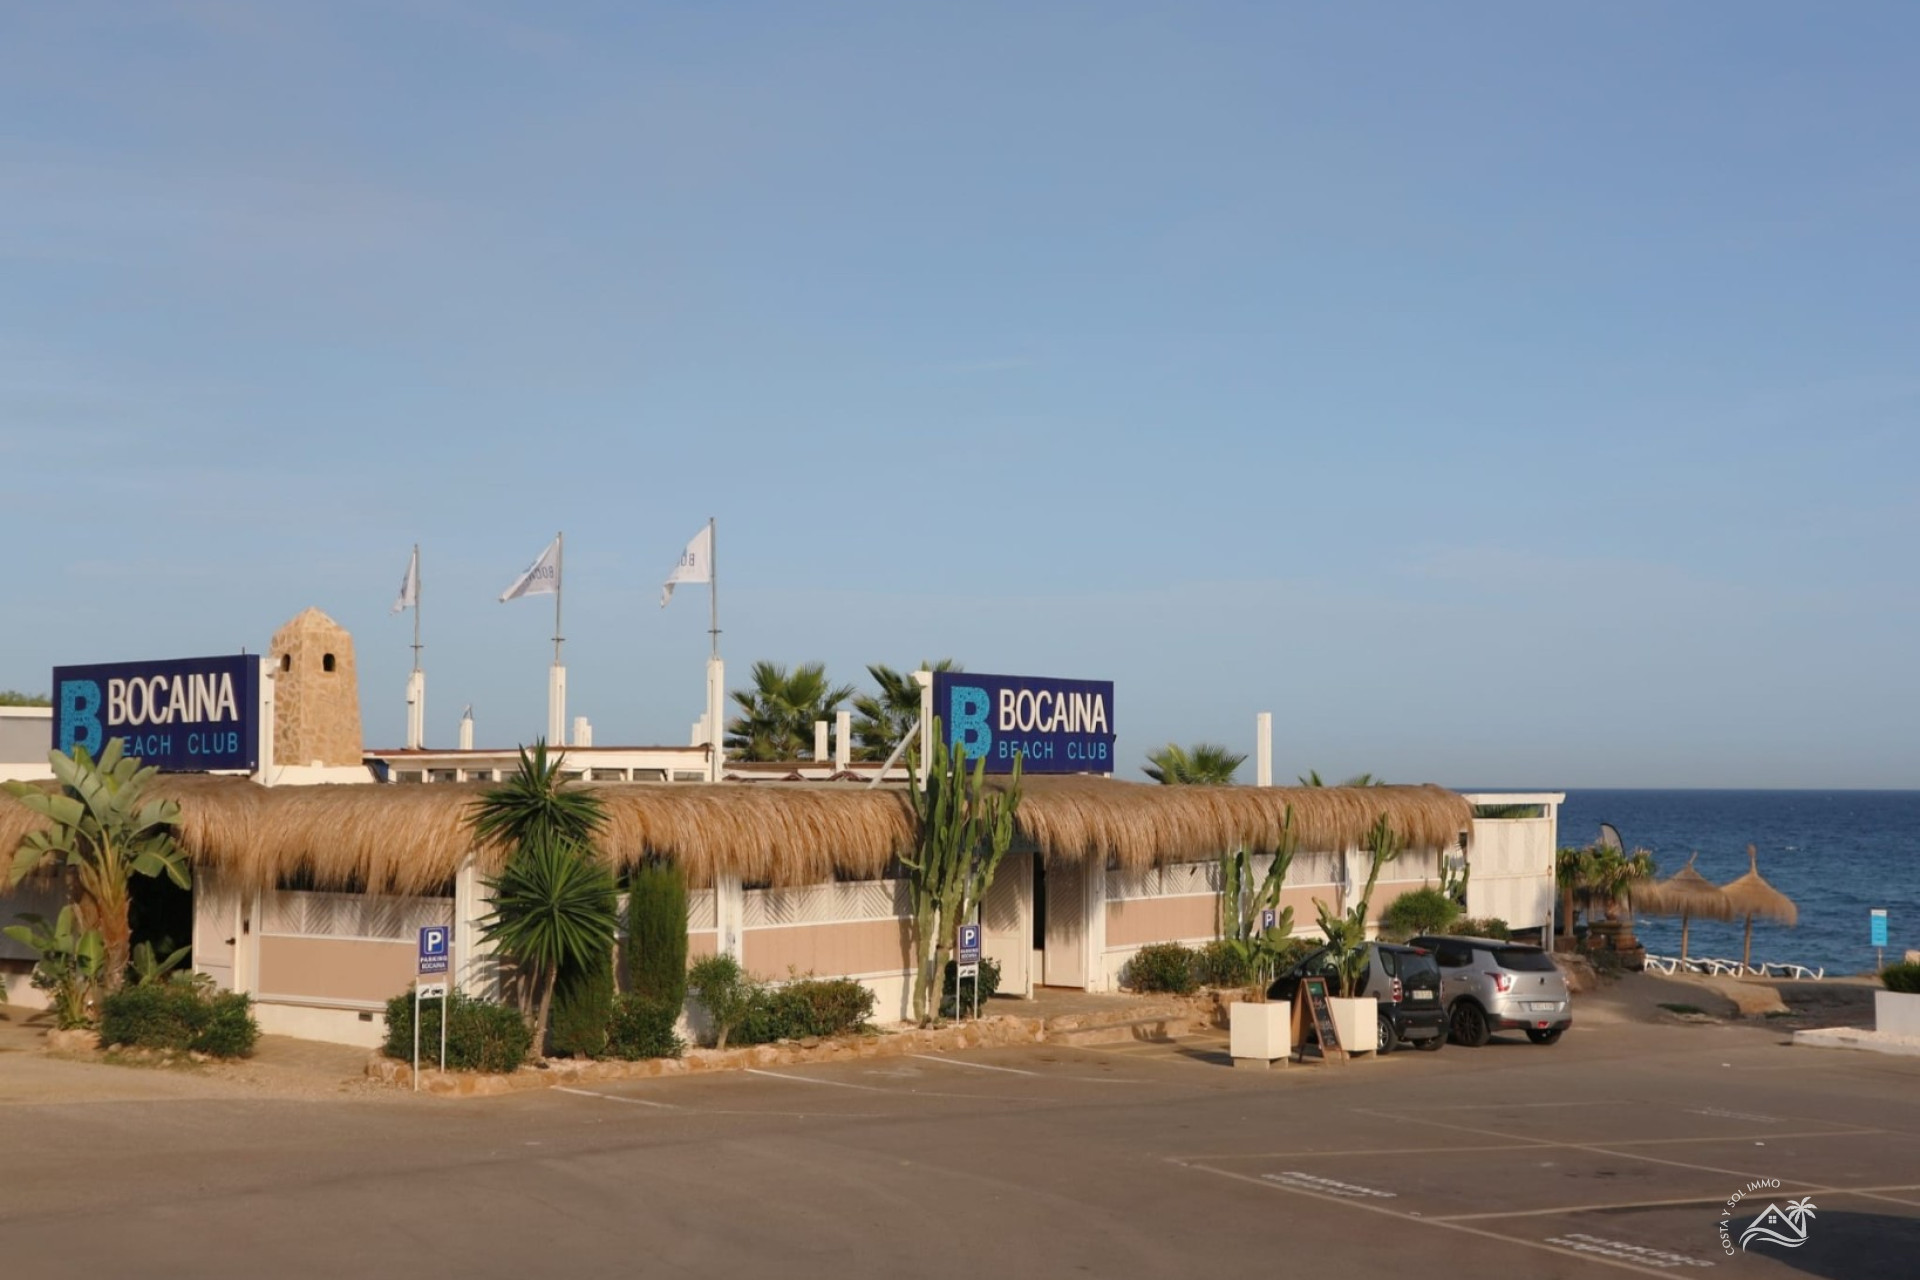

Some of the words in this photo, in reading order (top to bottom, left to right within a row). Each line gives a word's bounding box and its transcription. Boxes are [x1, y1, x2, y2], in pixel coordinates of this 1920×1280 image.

[108, 672, 239, 726] BOCAINA
[1000, 688, 1109, 734] BOCAINA
[60, 680, 102, 760] B
[951, 686, 993, 760] B
[121, 733, 172, 757] EACH
[187, 731, 239, 755] CLUB
[999, 741, 1054, 760] BEACH
[1067, 741, 1108, 760] CLUB
[428, 931, 442, 952] P
[965, 929, 975, 946] P
